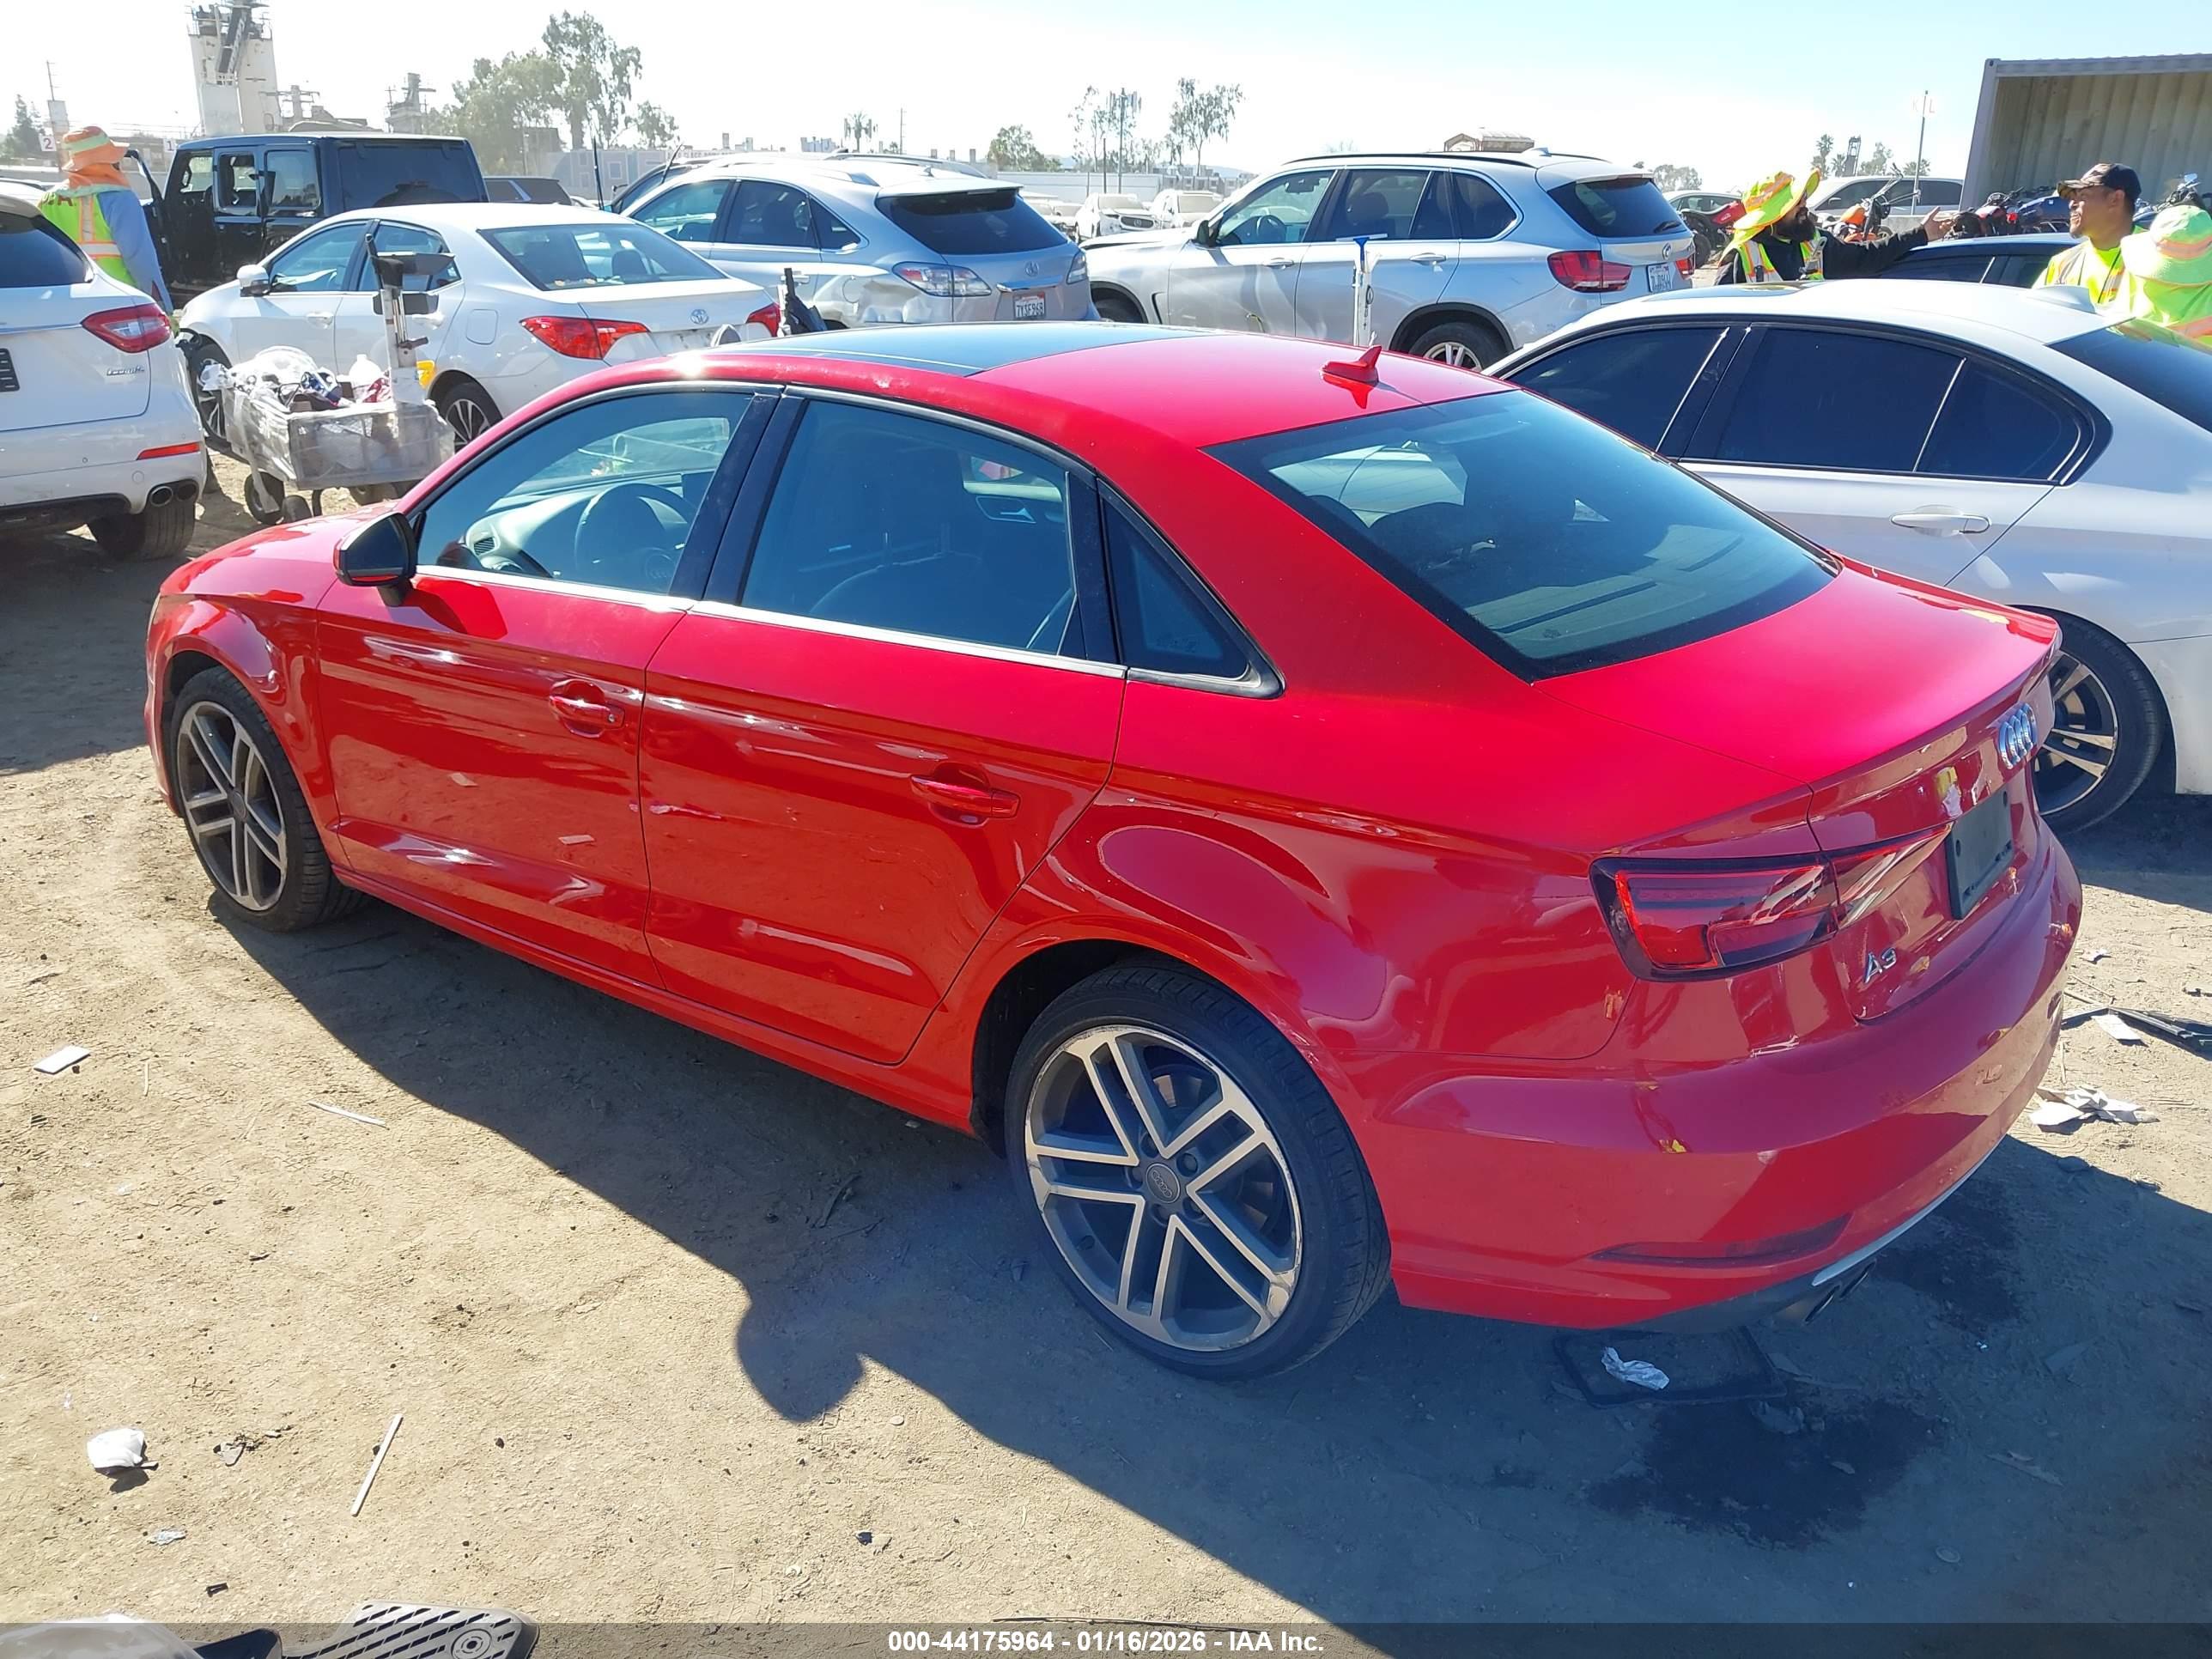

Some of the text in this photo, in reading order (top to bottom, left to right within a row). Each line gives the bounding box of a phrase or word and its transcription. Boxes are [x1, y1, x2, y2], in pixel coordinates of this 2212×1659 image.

[43, 137, 53, 149] 2
[167, 141, 174, 151] 1
[1864, 947, 1897, 984] A3
